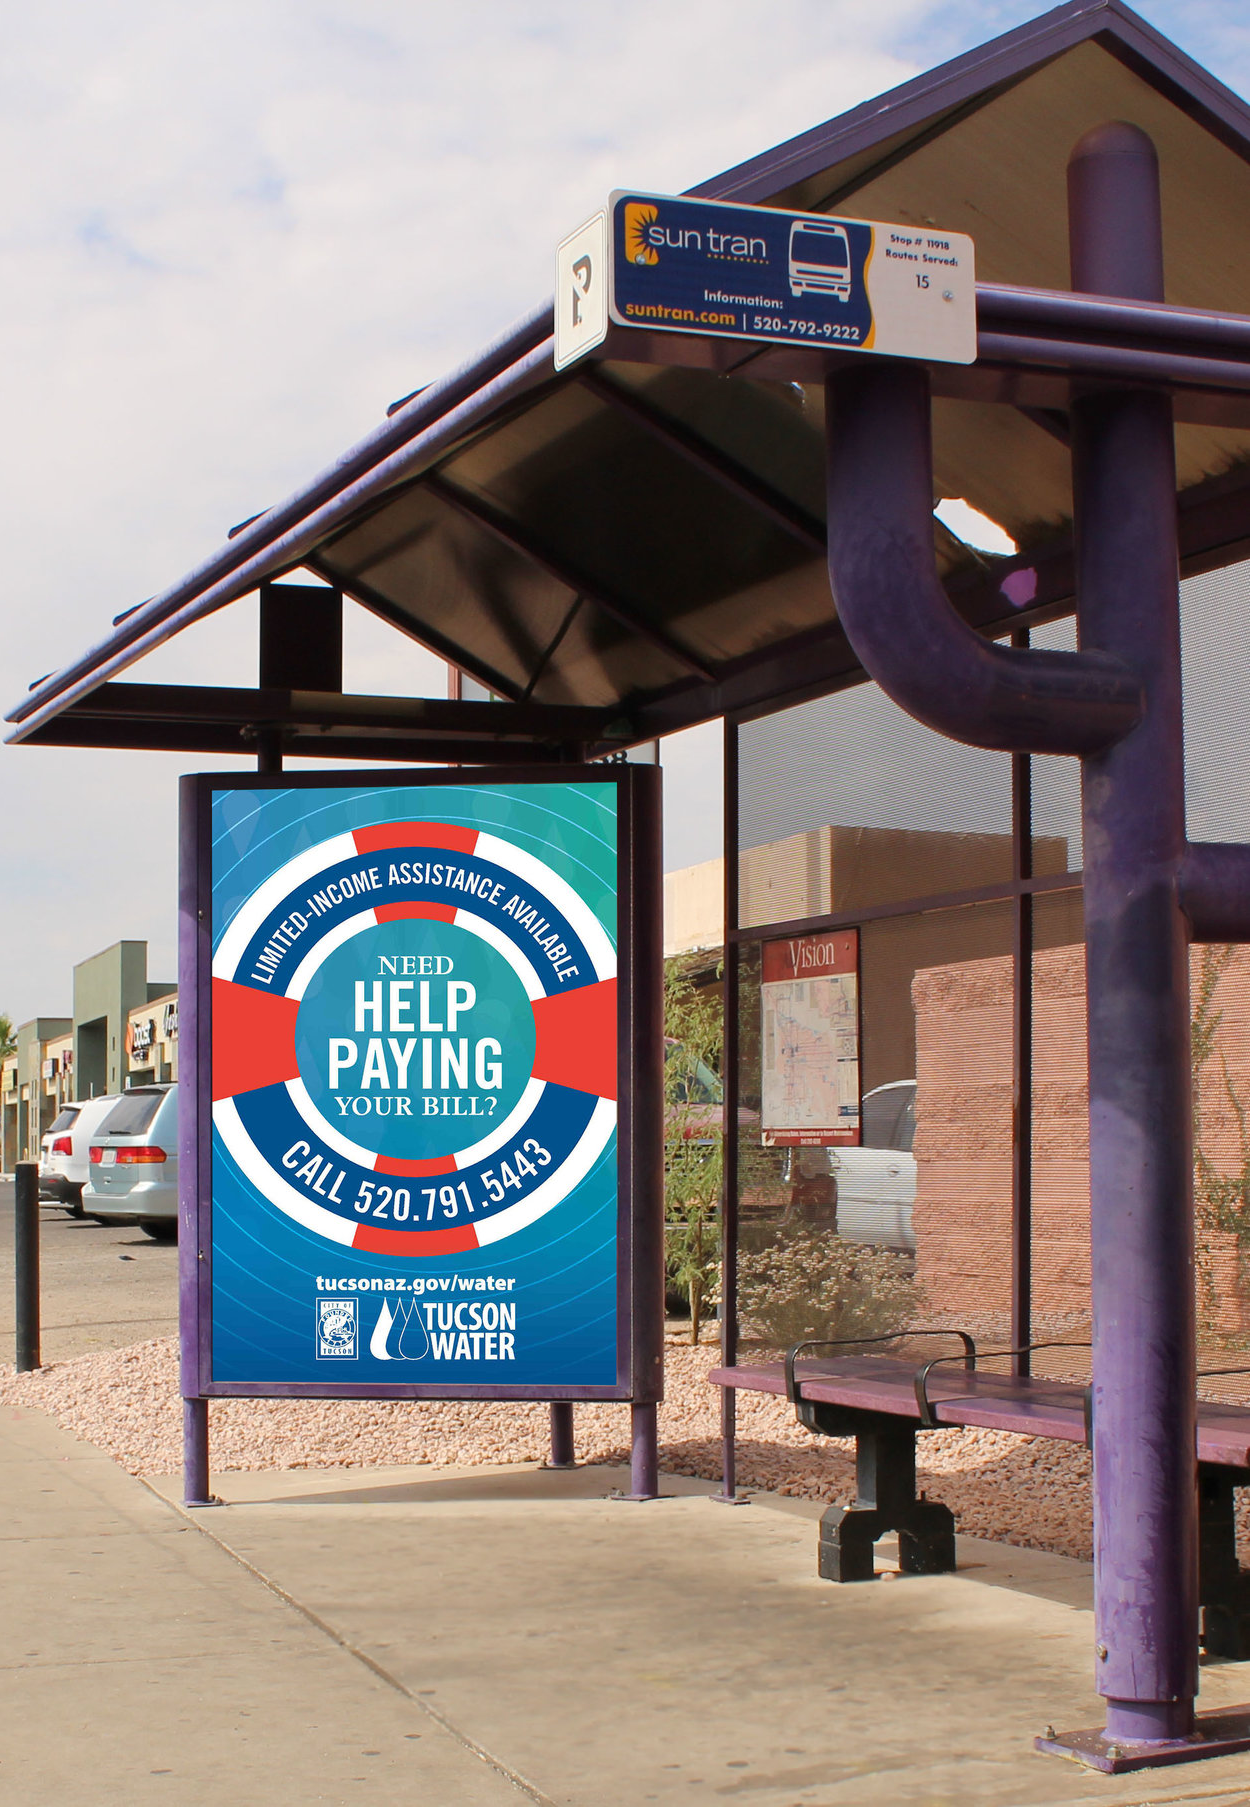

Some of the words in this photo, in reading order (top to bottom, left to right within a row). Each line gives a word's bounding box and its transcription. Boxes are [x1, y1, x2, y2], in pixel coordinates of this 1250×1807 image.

[648, 226, 701, 250] sun
[707, 232, 767, 258] tran
[889, 233, 913, 247] Stop
[926, 238, 950, 251] 11918
[885, 248, 918, 261] Routes
[921, 253, 959, 267] Served:
[915, 274, 930, 289] 15
[703, 289, 784, 310] Information:
[625, 302, 736, 326] suntran.com
[753, 316, 860, 341] 520-792-9222
[251, 867, 382, 985] LIMITED-INCOME
[388, 862, 505, 907] ASSISTANCE
[502, 894, 580, 984] AVAILABLE
[377, 956, 454, 976] NEED
[788, 940, 836, 977] Vision
[354, 980, 477, 1033] HELP
[328, 1037, 503, 1090] PAYING
[335, 1096, 414, 1117] YOUR
[422, 1096, 498, 1117] BILL?
[281, 1139, 346, 1204] CALL
[354, 1137, 553, 1222] 520.791.5443
[316, 1274, 516, 1295] tucsonaz.gov/water
[423, 1301, 516, 1331] TUCSON
[430, 1333, 516, 1360] WATER
